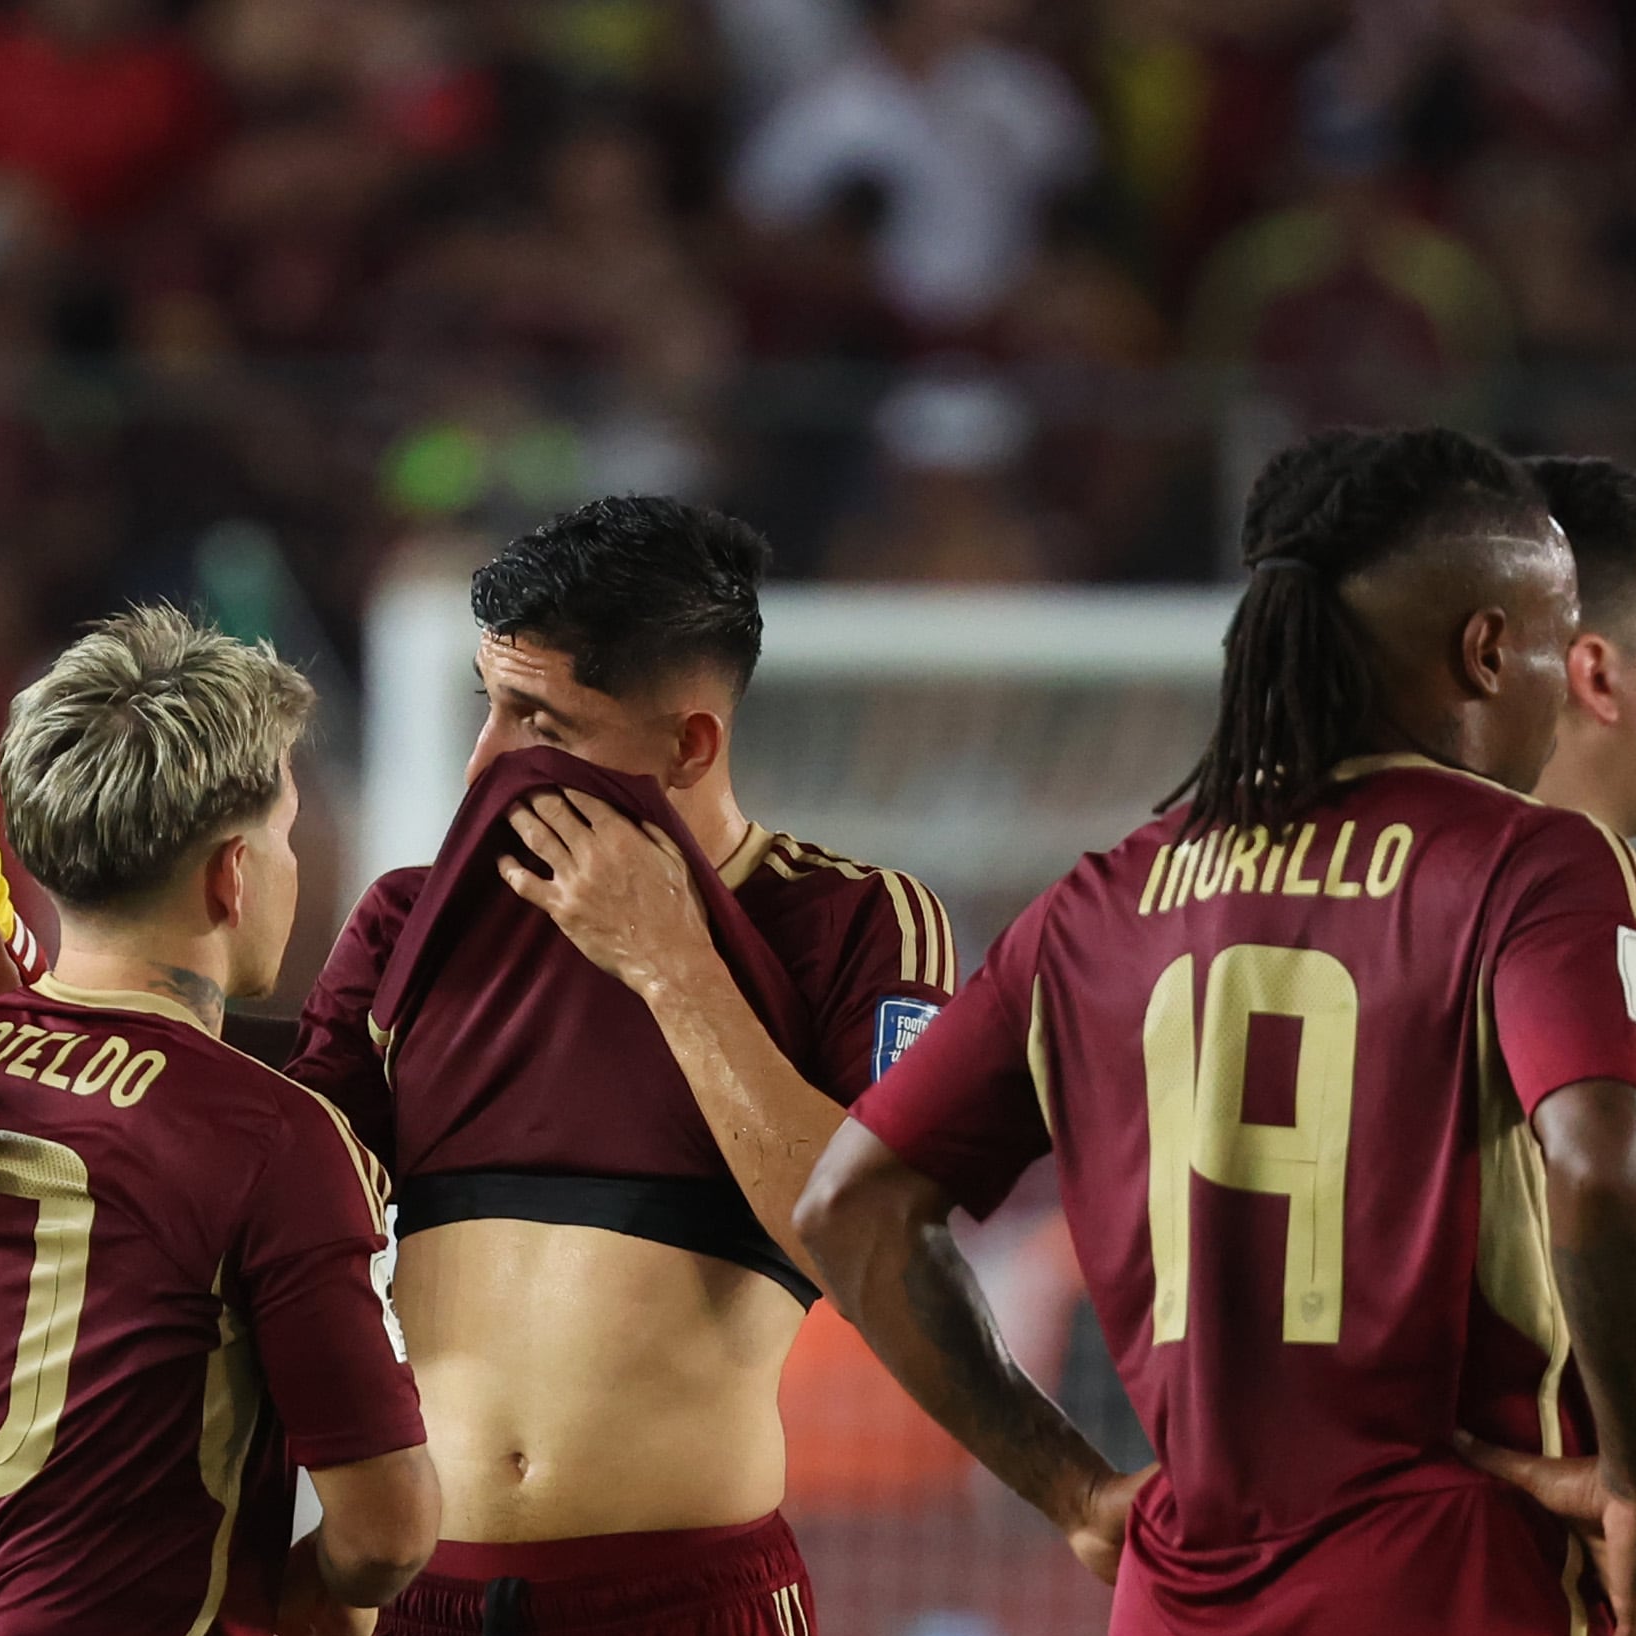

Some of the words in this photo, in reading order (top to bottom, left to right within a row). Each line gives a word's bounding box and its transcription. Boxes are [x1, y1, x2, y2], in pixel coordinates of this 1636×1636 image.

[1138, 820, 1414, 916] MURILLO
[897, 1015, 930, 1034] FOOT
[1143, 943, 1358, 1346] 19
